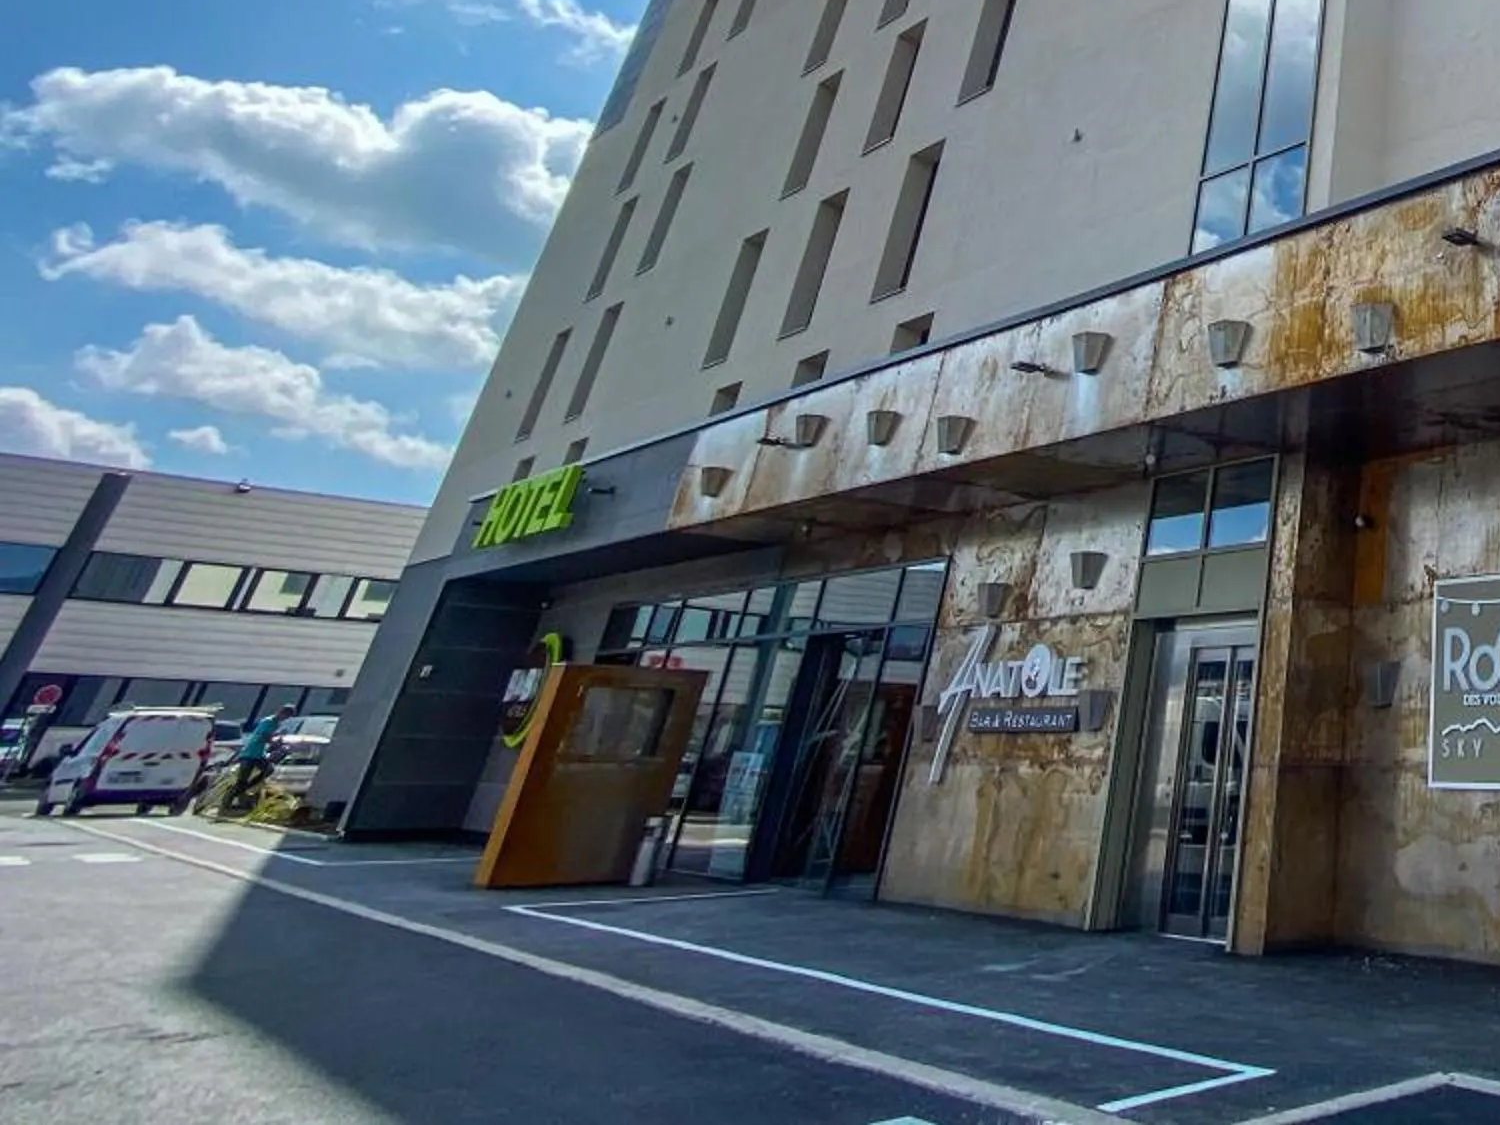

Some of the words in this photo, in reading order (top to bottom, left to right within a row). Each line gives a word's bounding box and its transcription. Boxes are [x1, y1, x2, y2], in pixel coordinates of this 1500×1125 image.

[471, 463, 585, 549] HOTEL
[929, 623, 1084, 784] ANATOLE
[1463, 694, 1480, 706] DES
[1003, 710, 1072, 728] RESTAURANT
[1441, 738, 1482, 758] SKY
